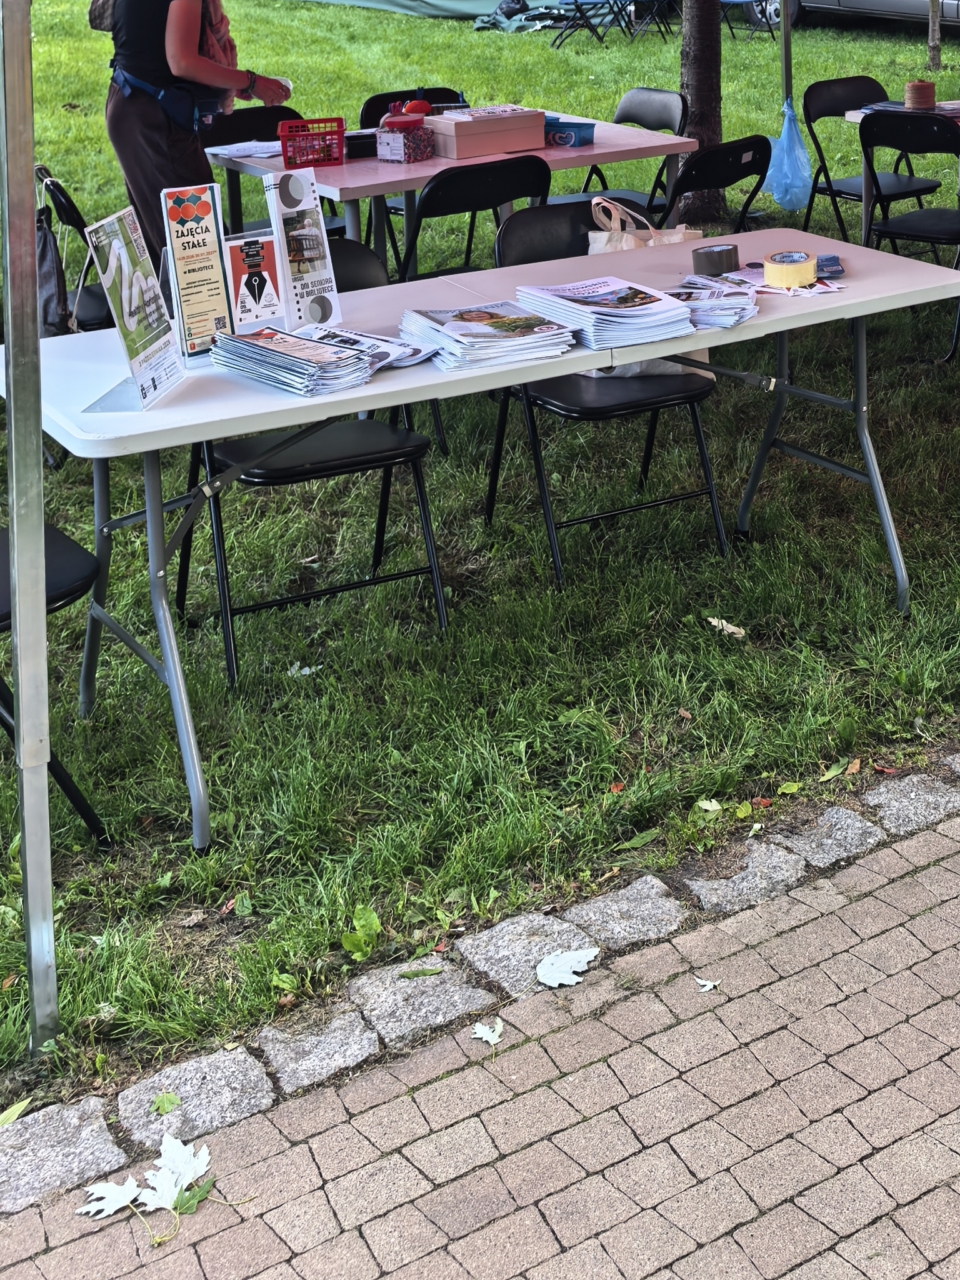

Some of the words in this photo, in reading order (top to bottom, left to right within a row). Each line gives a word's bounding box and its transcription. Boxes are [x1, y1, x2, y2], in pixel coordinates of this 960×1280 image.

[175, 225, 211, 239] ZAJĘCIA
[182, 238, 207, 251] STAŁE
[188, 264, 214, 274] BIBLIOTECE
[311, 277, 332, 288] SENIORA
[306, 285, 334, 297] BIBLIOTECE
